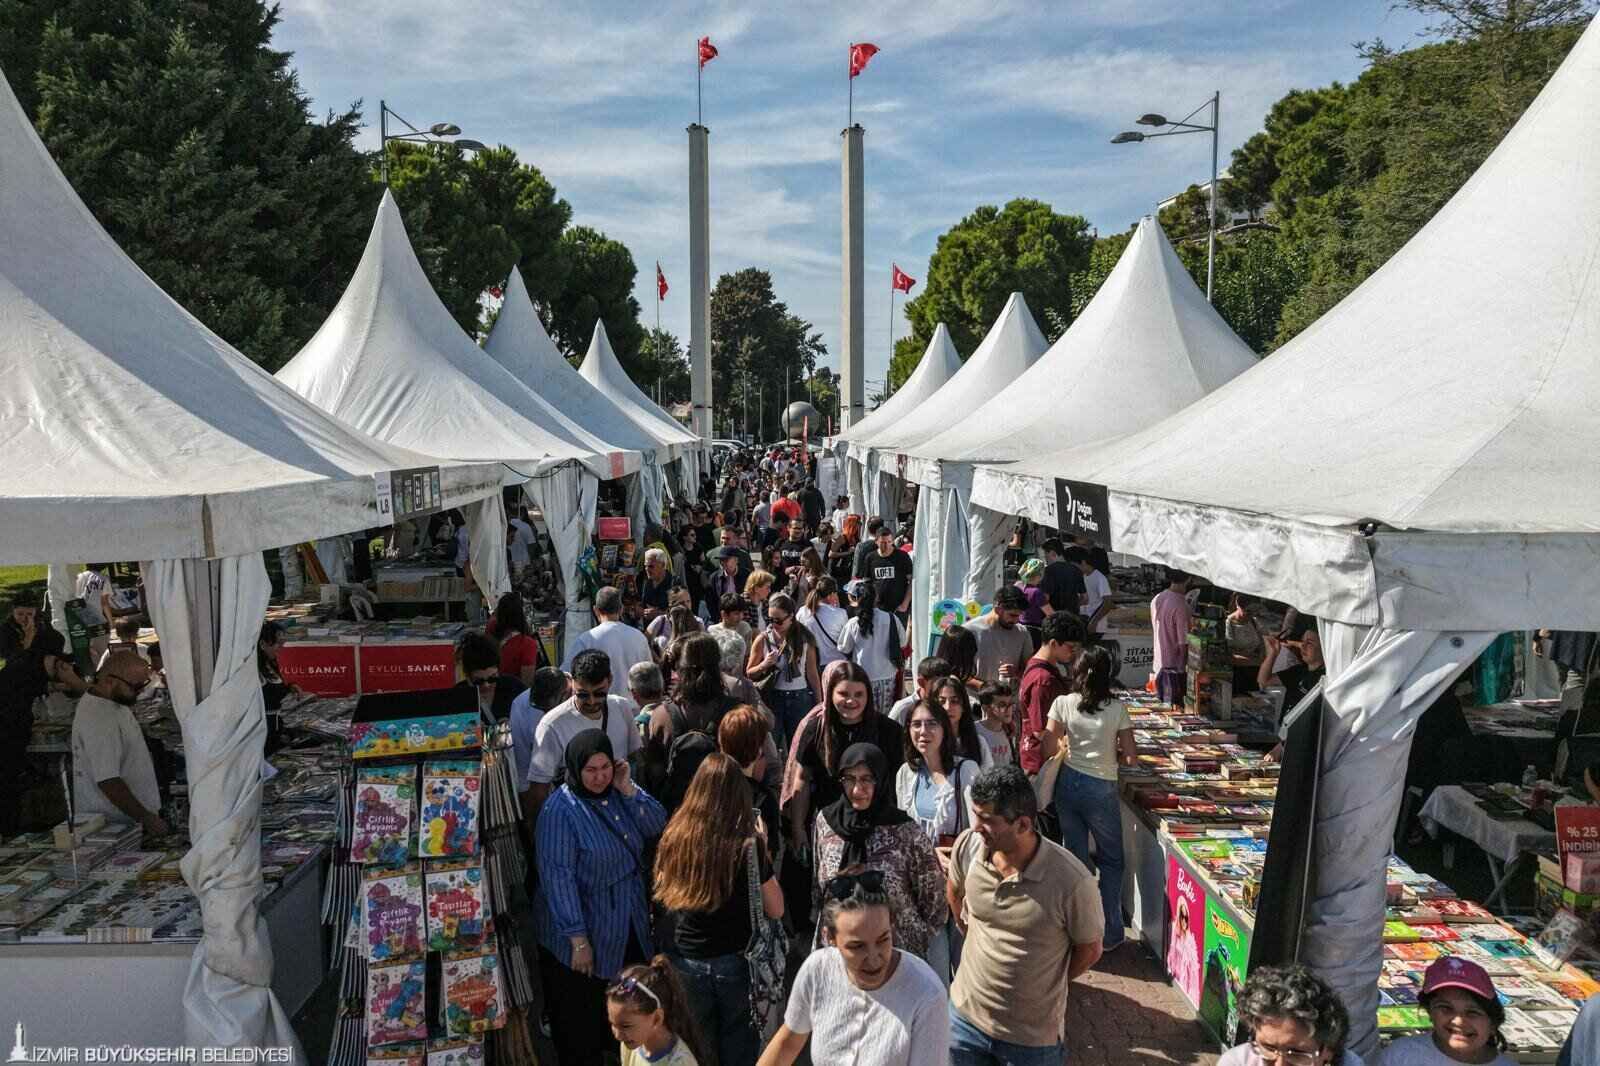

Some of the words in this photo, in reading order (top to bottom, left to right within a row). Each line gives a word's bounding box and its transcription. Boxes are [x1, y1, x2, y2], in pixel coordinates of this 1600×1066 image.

[1076, 500, 1093, 517] Doğan
[1127, 647, 1154, 656] TİTAN
[279, 664, 305, 674] YLUL
[308, 665, 348, 674] SANAT
[407, 664, 447, 673] SANAT
[1567, 826, 1580, 838] %
[1582, 826, 1598, 838] 25
[1177, 867, 1197, 903] Barbie
